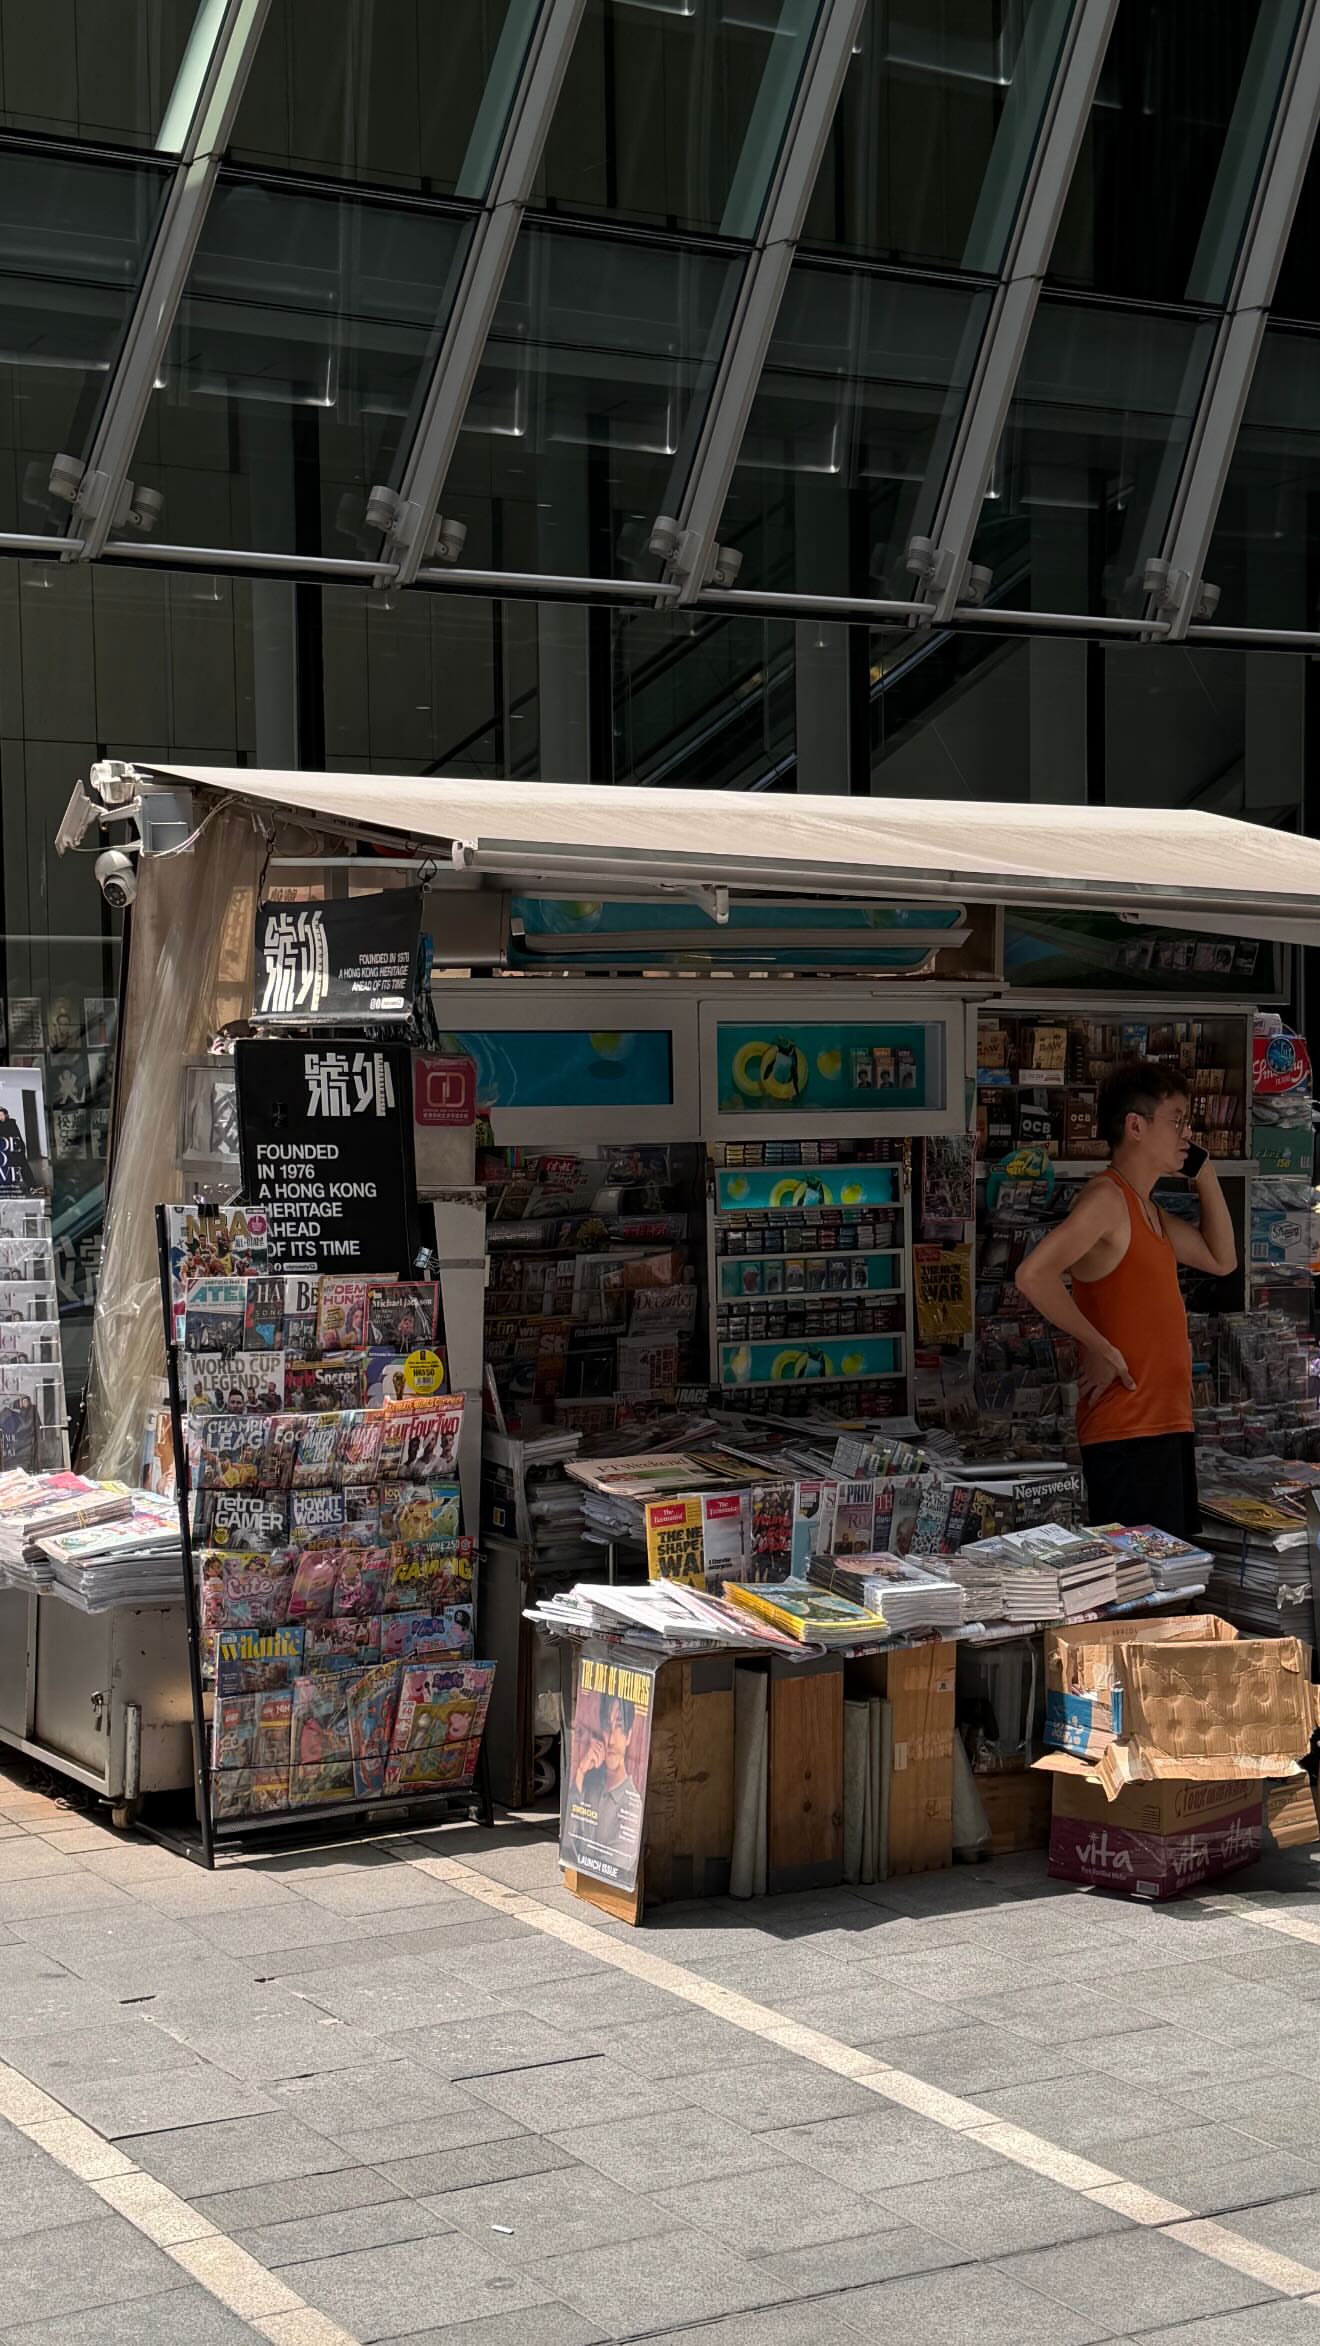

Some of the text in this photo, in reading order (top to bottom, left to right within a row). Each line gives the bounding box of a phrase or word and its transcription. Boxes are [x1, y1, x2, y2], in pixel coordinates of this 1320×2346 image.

[359, 953, 389, 965] FOUNDED
[343, 968, 361, 979] HONG
[361, 967, 379, 978] KONG
[379, 966, 409, 977] HERITAGE
[351, 980, 372, 992] AHEAD
[391, 979, 407, 990] TIME
[1070, 1113, 1091, 1122] OCB
[1022, 1120, 1052, 1135] OCB
[256, 1144, 340, 1160] FOUNDED
[257, 1163, 316, 1179] IN 1976
[258, 1182, 377, 1199] A HONG KONG
[186, 1211, 251, 1242] NBA
[290, 1241, 317, 1256] ITS
[320, 1240, 361, 1255] TIME
[638, 1291, 691, 1309] Decanter
[921, 1284, 962, 1302] WAR
[191, 1357, 281, 1375] WORLD CUP
[203, 1374, 268, 1391] LEGENDS
[315, 1370, 358, 1386] Soccer
[1015, 1474, 1080, 1499] Newsweek
[216, 1494, 263, 1513] retro
[294, 1496, 341, 1513] HOW IT
[215, 1511, 284, 1531] GAMER
[294, 1510, 342, 1525] WORKS
[657, 1530, 685, 1543] THE
[657, 1540, 700, 1556] SHAPE
[226, 1576, 274, 1601] Cute
[581, 1659, 651, 1706] THE ART OF WELLNESS
[1076, 1831, 1134, 1873] vita
[577, 1854, 602, 1872] LAUNCH
